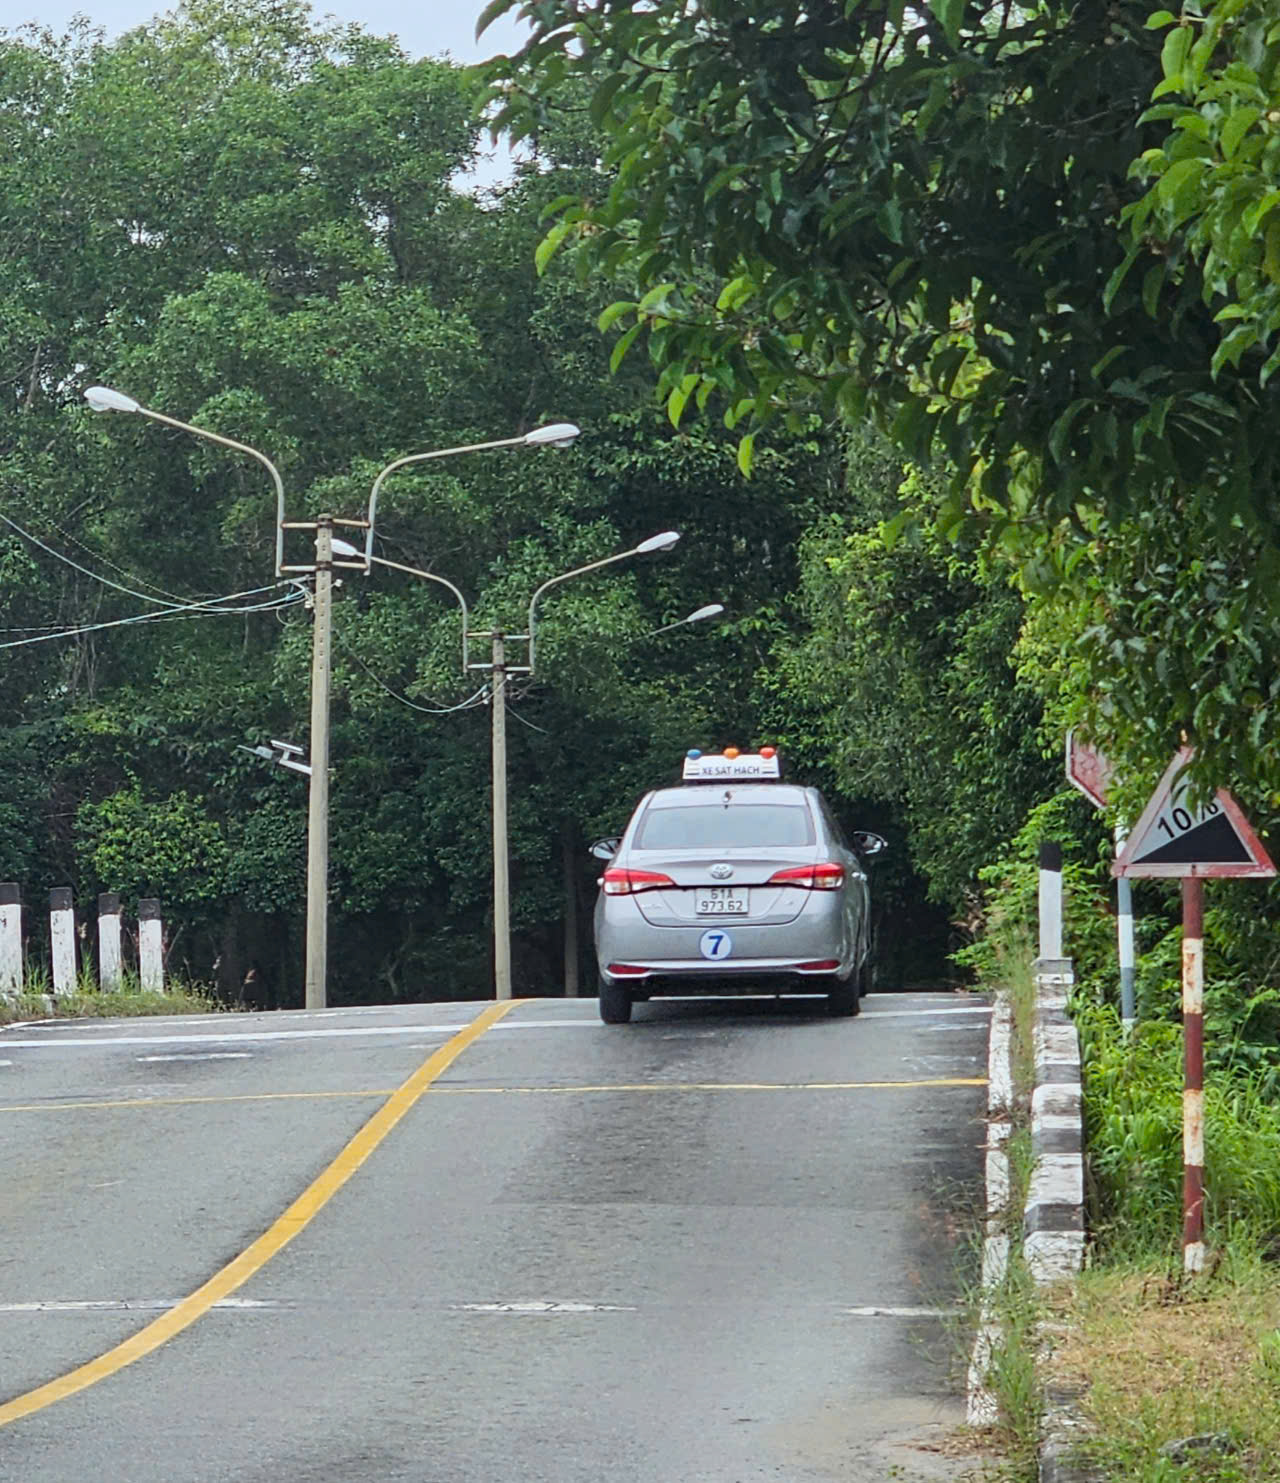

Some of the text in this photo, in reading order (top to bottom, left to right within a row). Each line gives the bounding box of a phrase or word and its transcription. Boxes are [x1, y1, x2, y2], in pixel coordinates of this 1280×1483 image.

[702, 766, 713, 775] XE
[711, 888, 733, 899] 61A
[701, 901, 743, 911] 973.62
[708, 935, 724, 955] 7
